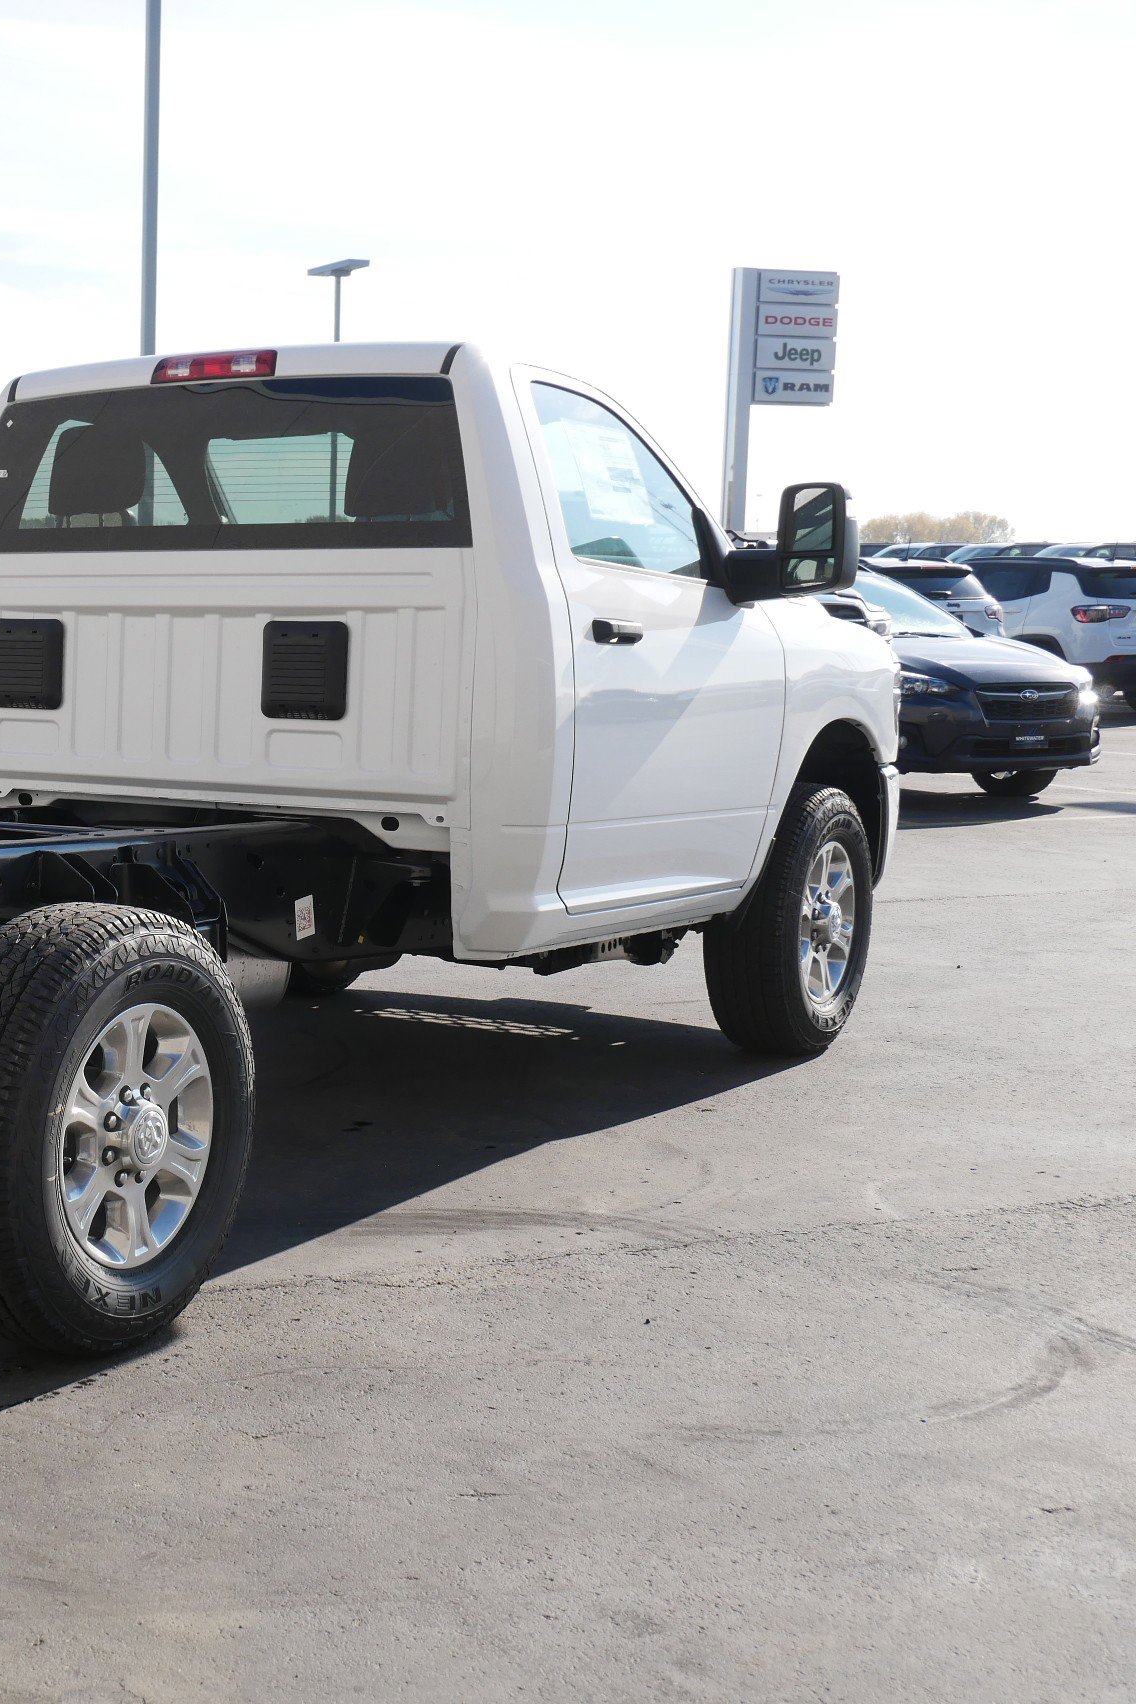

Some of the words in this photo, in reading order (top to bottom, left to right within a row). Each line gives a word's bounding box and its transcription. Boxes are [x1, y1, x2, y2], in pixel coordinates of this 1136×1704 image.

[768, 278, 834, 287] CHRYSLER
[765, 315, 833, 327] DODGE
[773, 342, 822, 365] Jeep
[782, 382, 830, 393] RAM
